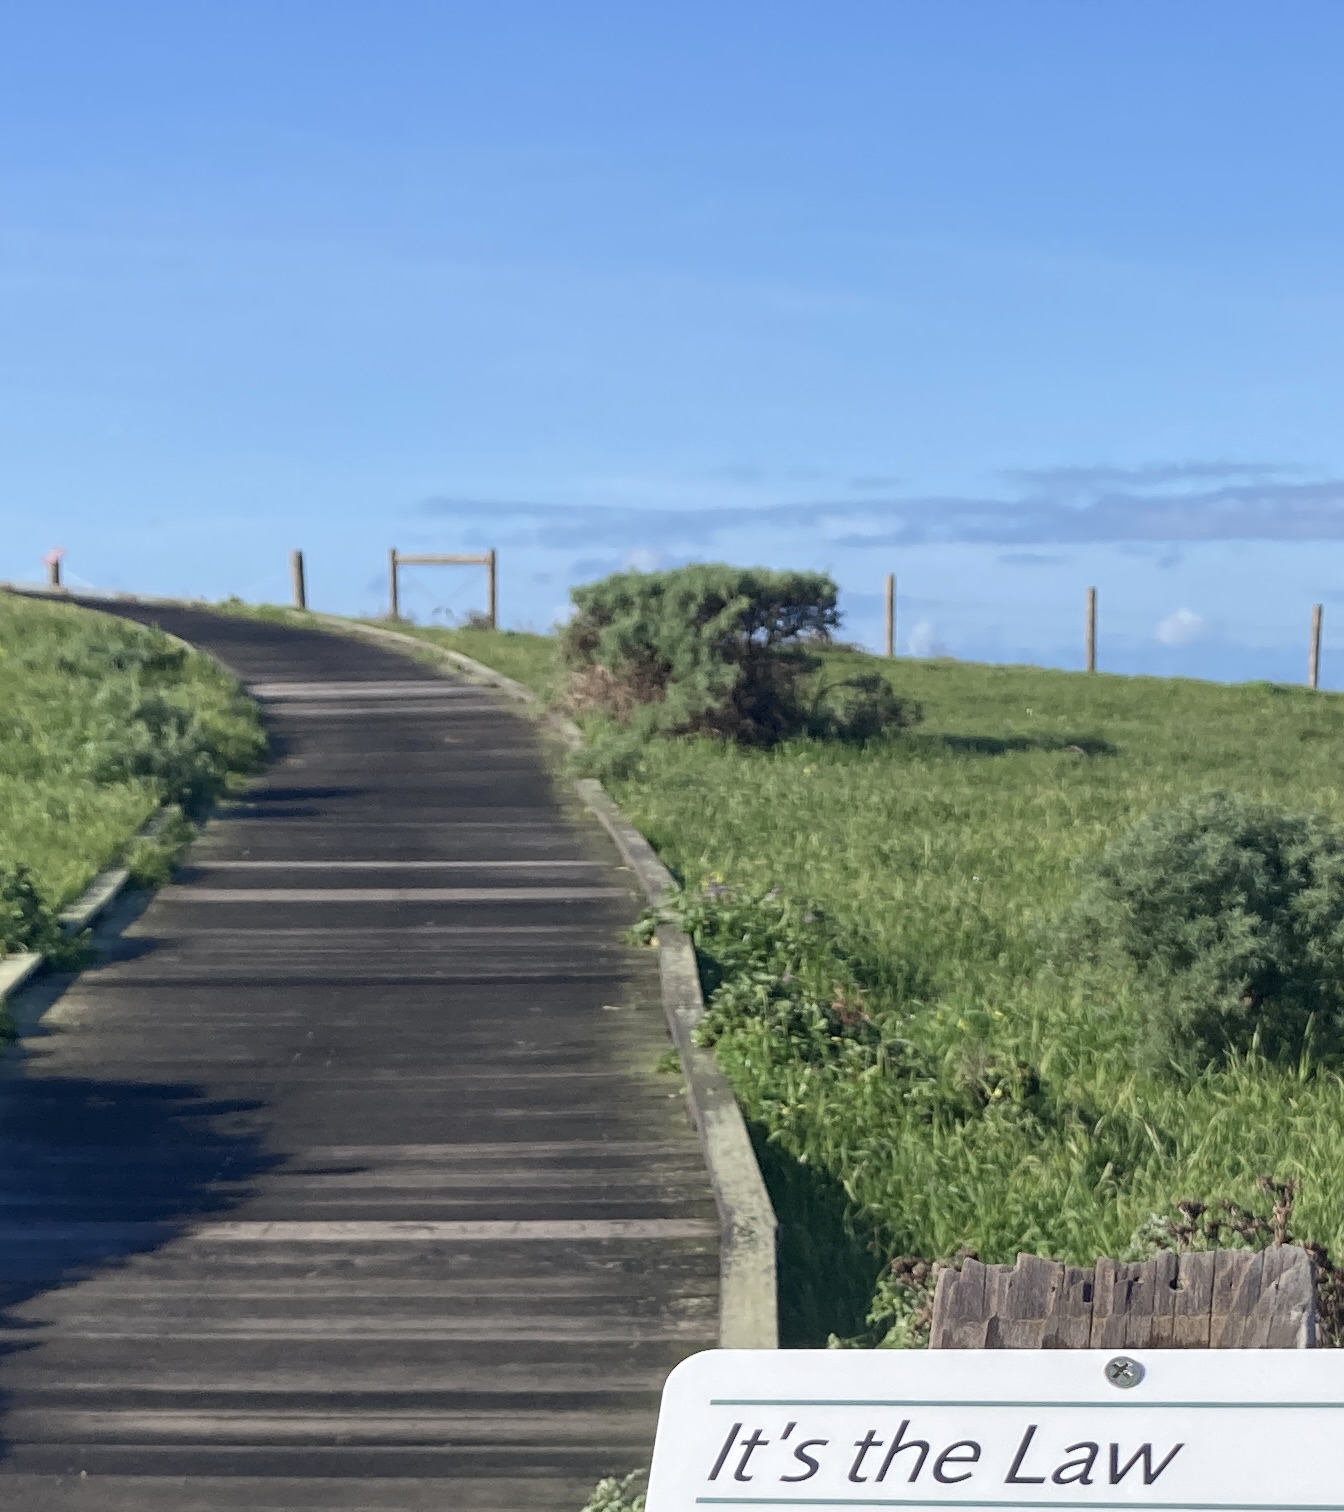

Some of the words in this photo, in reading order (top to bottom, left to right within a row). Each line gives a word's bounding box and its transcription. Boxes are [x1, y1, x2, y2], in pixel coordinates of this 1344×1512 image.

[708, 1422, 829, 1482] It's
[848, 1420, 981, 1483] the
[1004, 1425, 1184, 1485] Law
